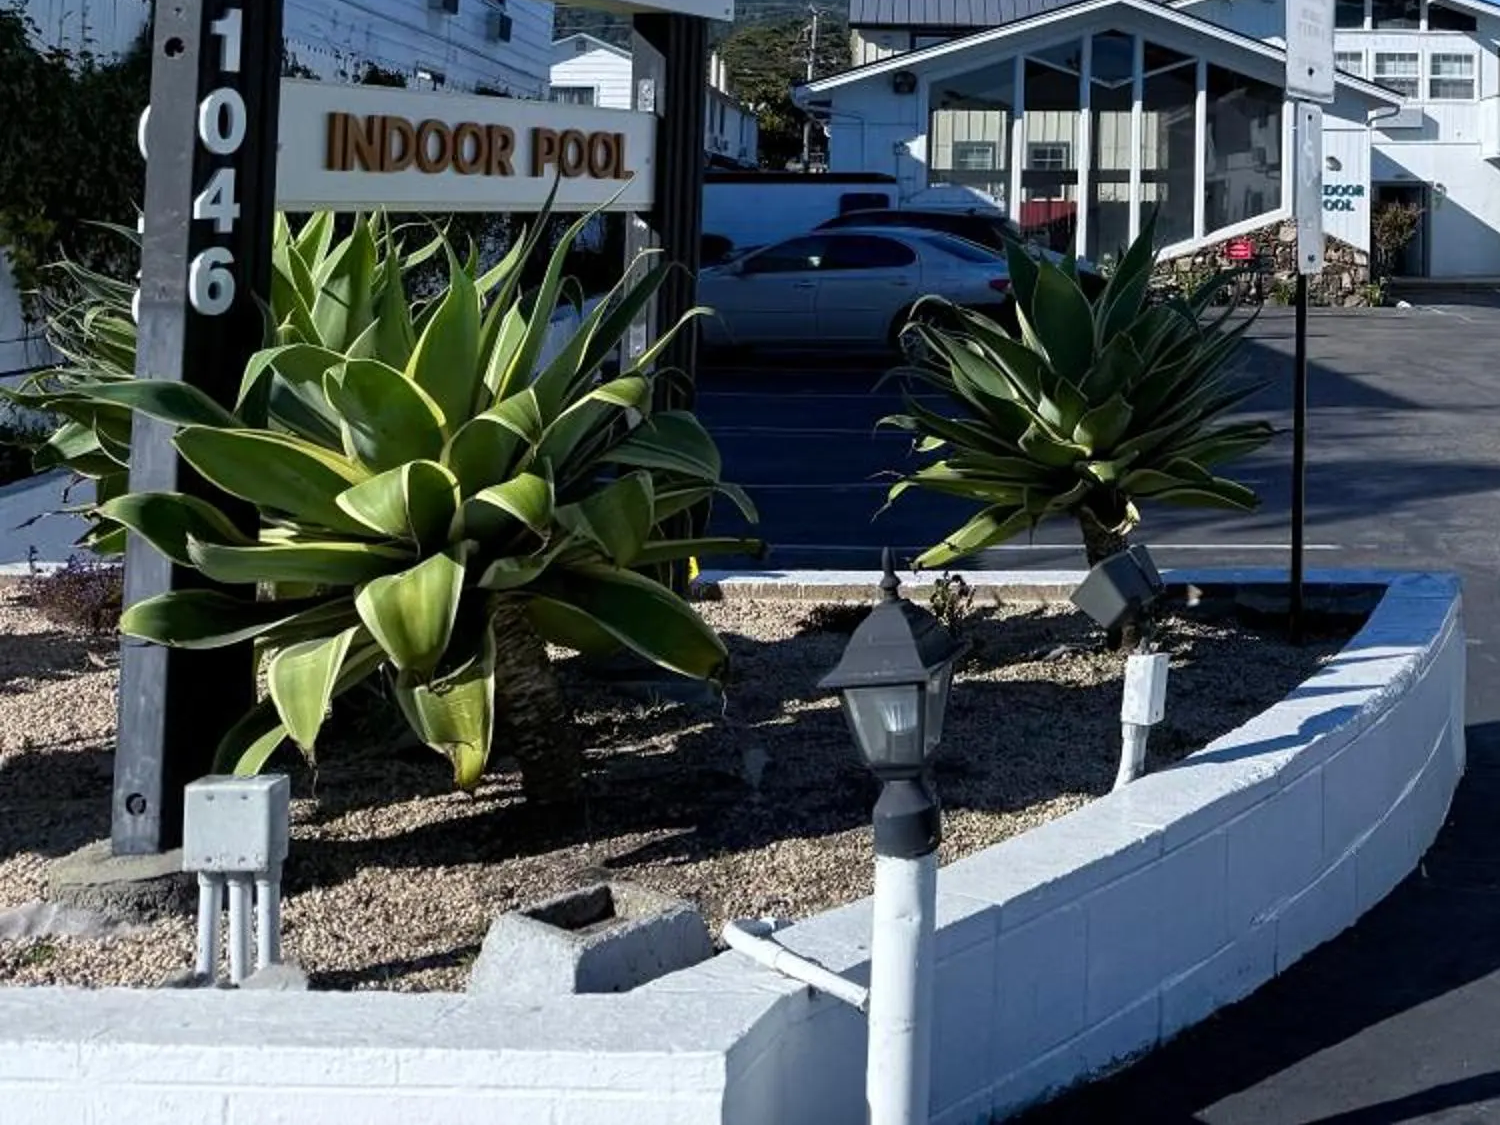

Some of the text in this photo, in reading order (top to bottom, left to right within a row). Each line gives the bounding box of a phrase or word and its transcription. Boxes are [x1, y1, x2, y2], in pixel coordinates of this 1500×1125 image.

[189, 7, 247, 316] 1046
[327, 111, 635, 179] INDOOR POOL
[1323, 184, 1364, 197] DOOR
[1323, 199, 1355, 211] OOL
